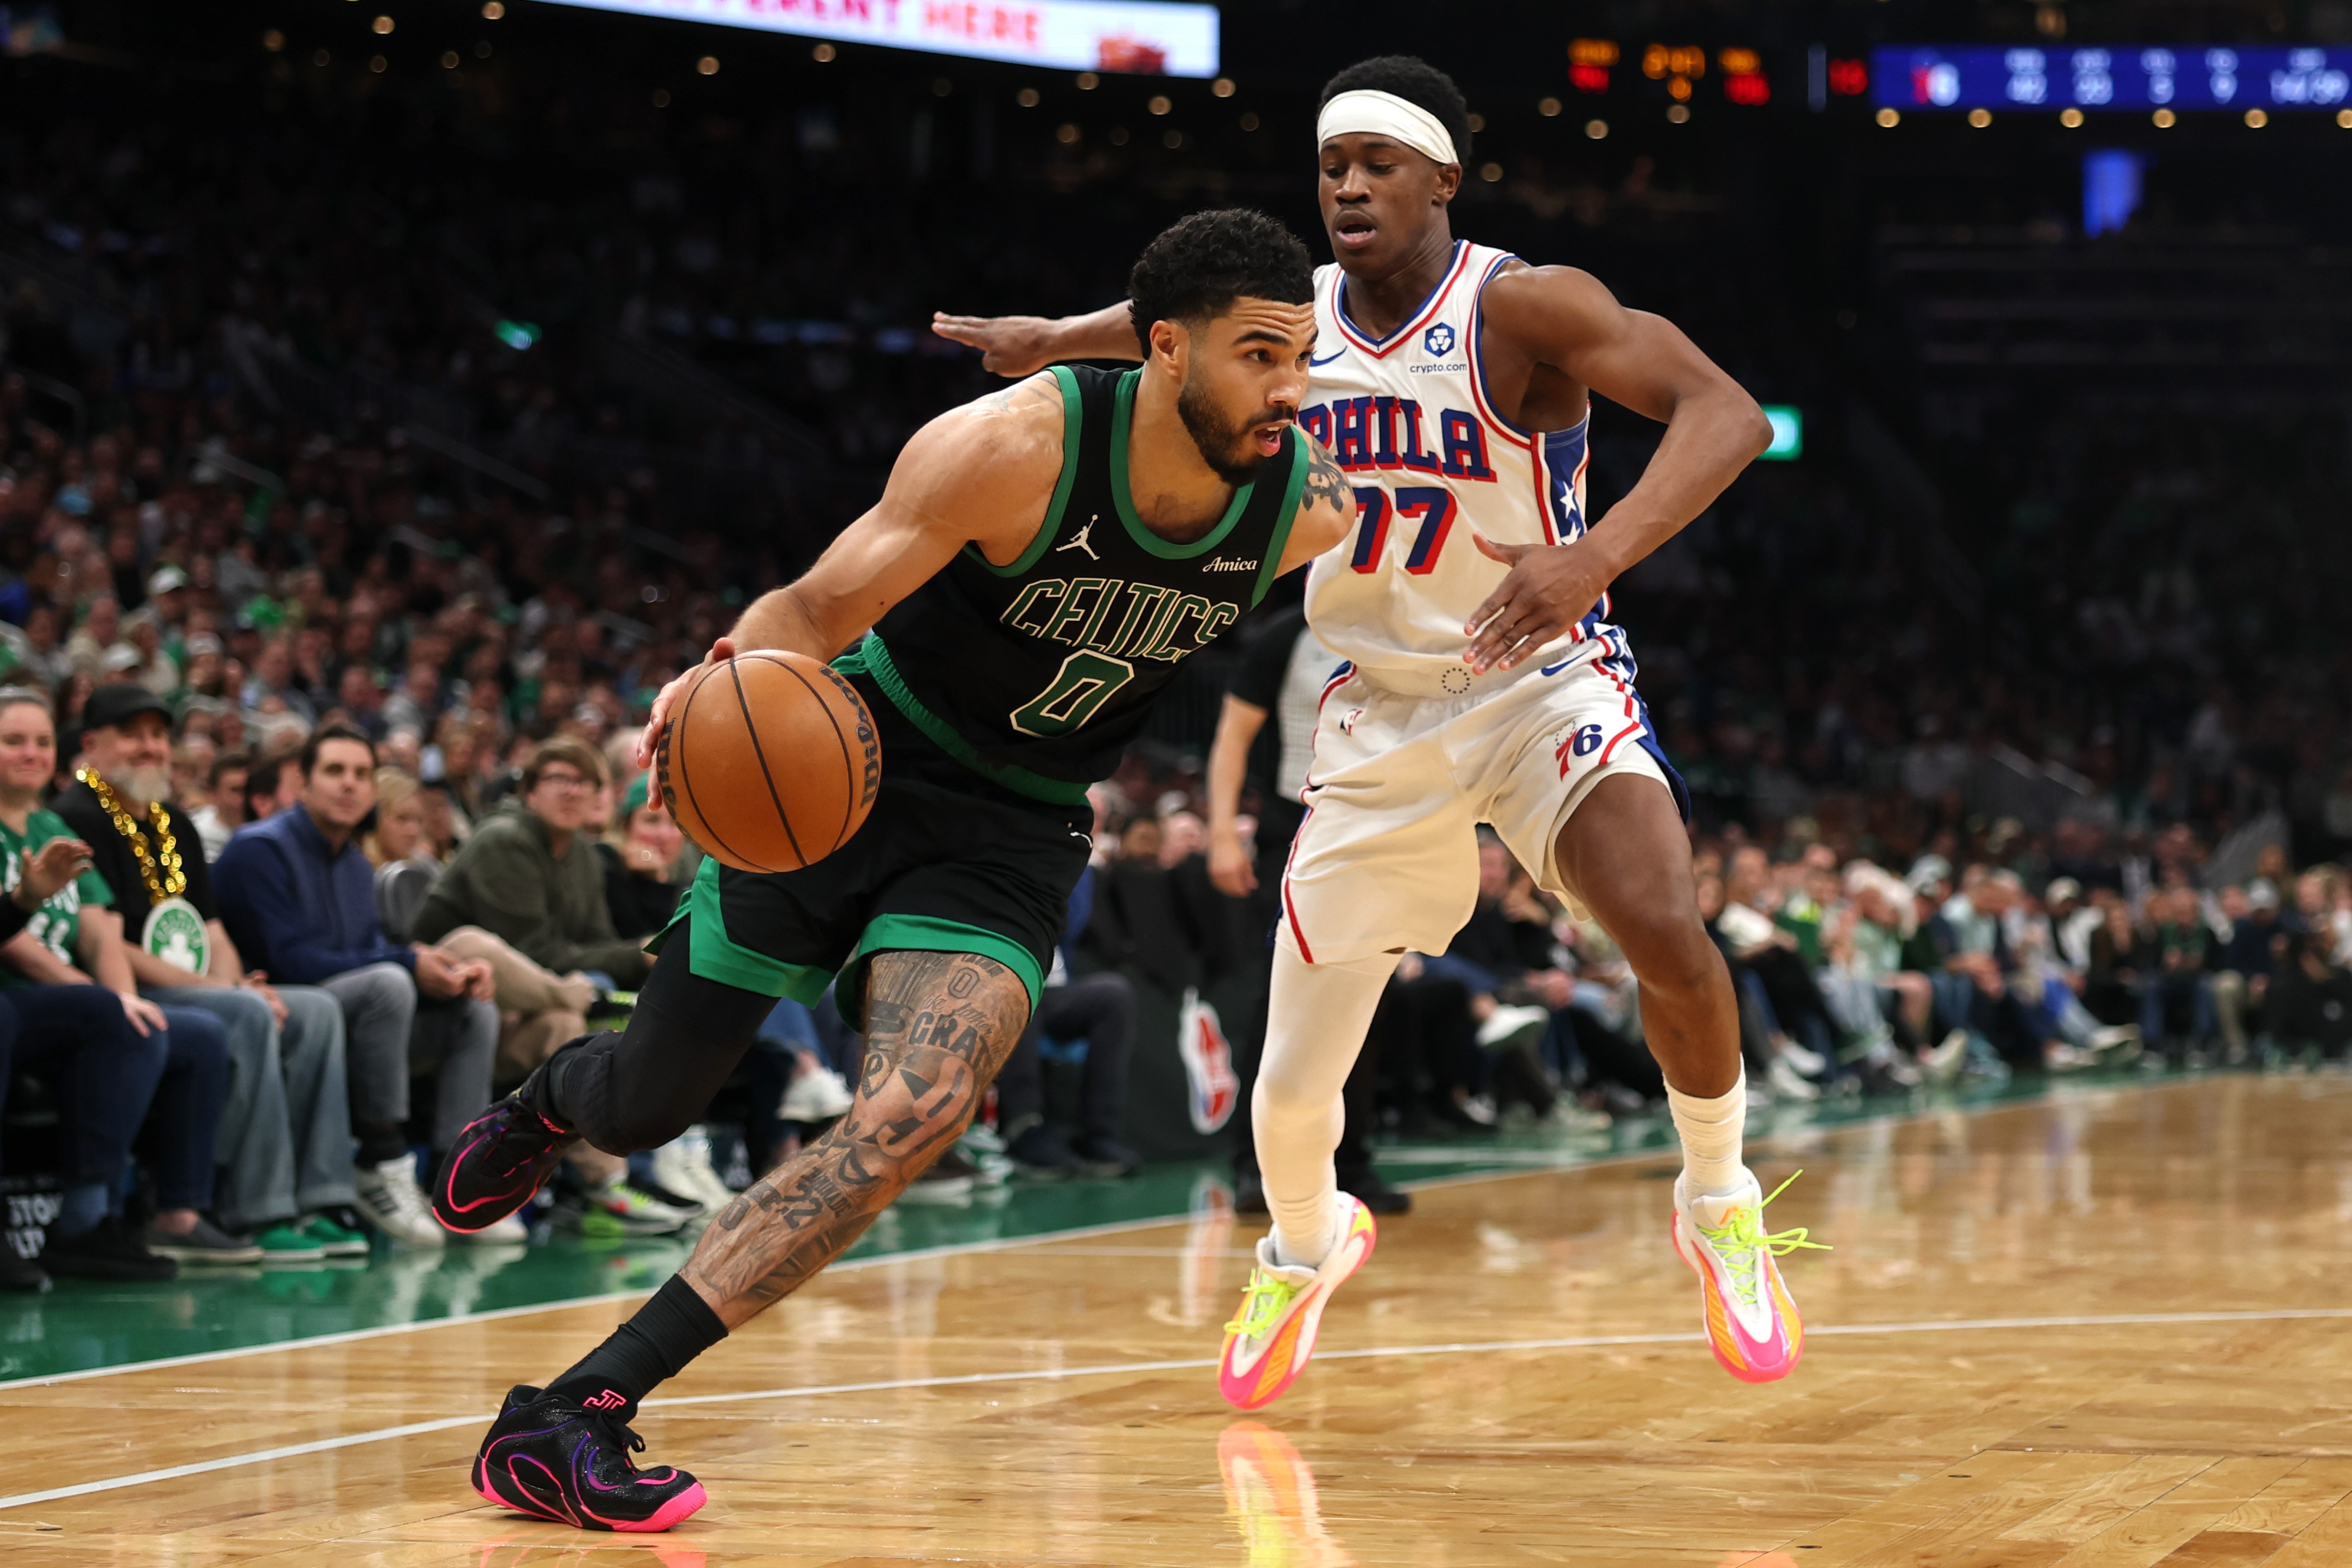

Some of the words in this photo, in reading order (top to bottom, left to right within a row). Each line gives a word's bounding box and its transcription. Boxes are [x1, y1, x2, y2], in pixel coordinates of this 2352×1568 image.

[1409, 362, 1467, 374] crypto.com
[1297, 395, 1497, 483] PHILA
[1202, 557, 1258, 573] Amica
[1351, 487, 1457, 575] 77
[1009, 649, 1134, 739] 0
[1555, 724, 1602, 782] 76
